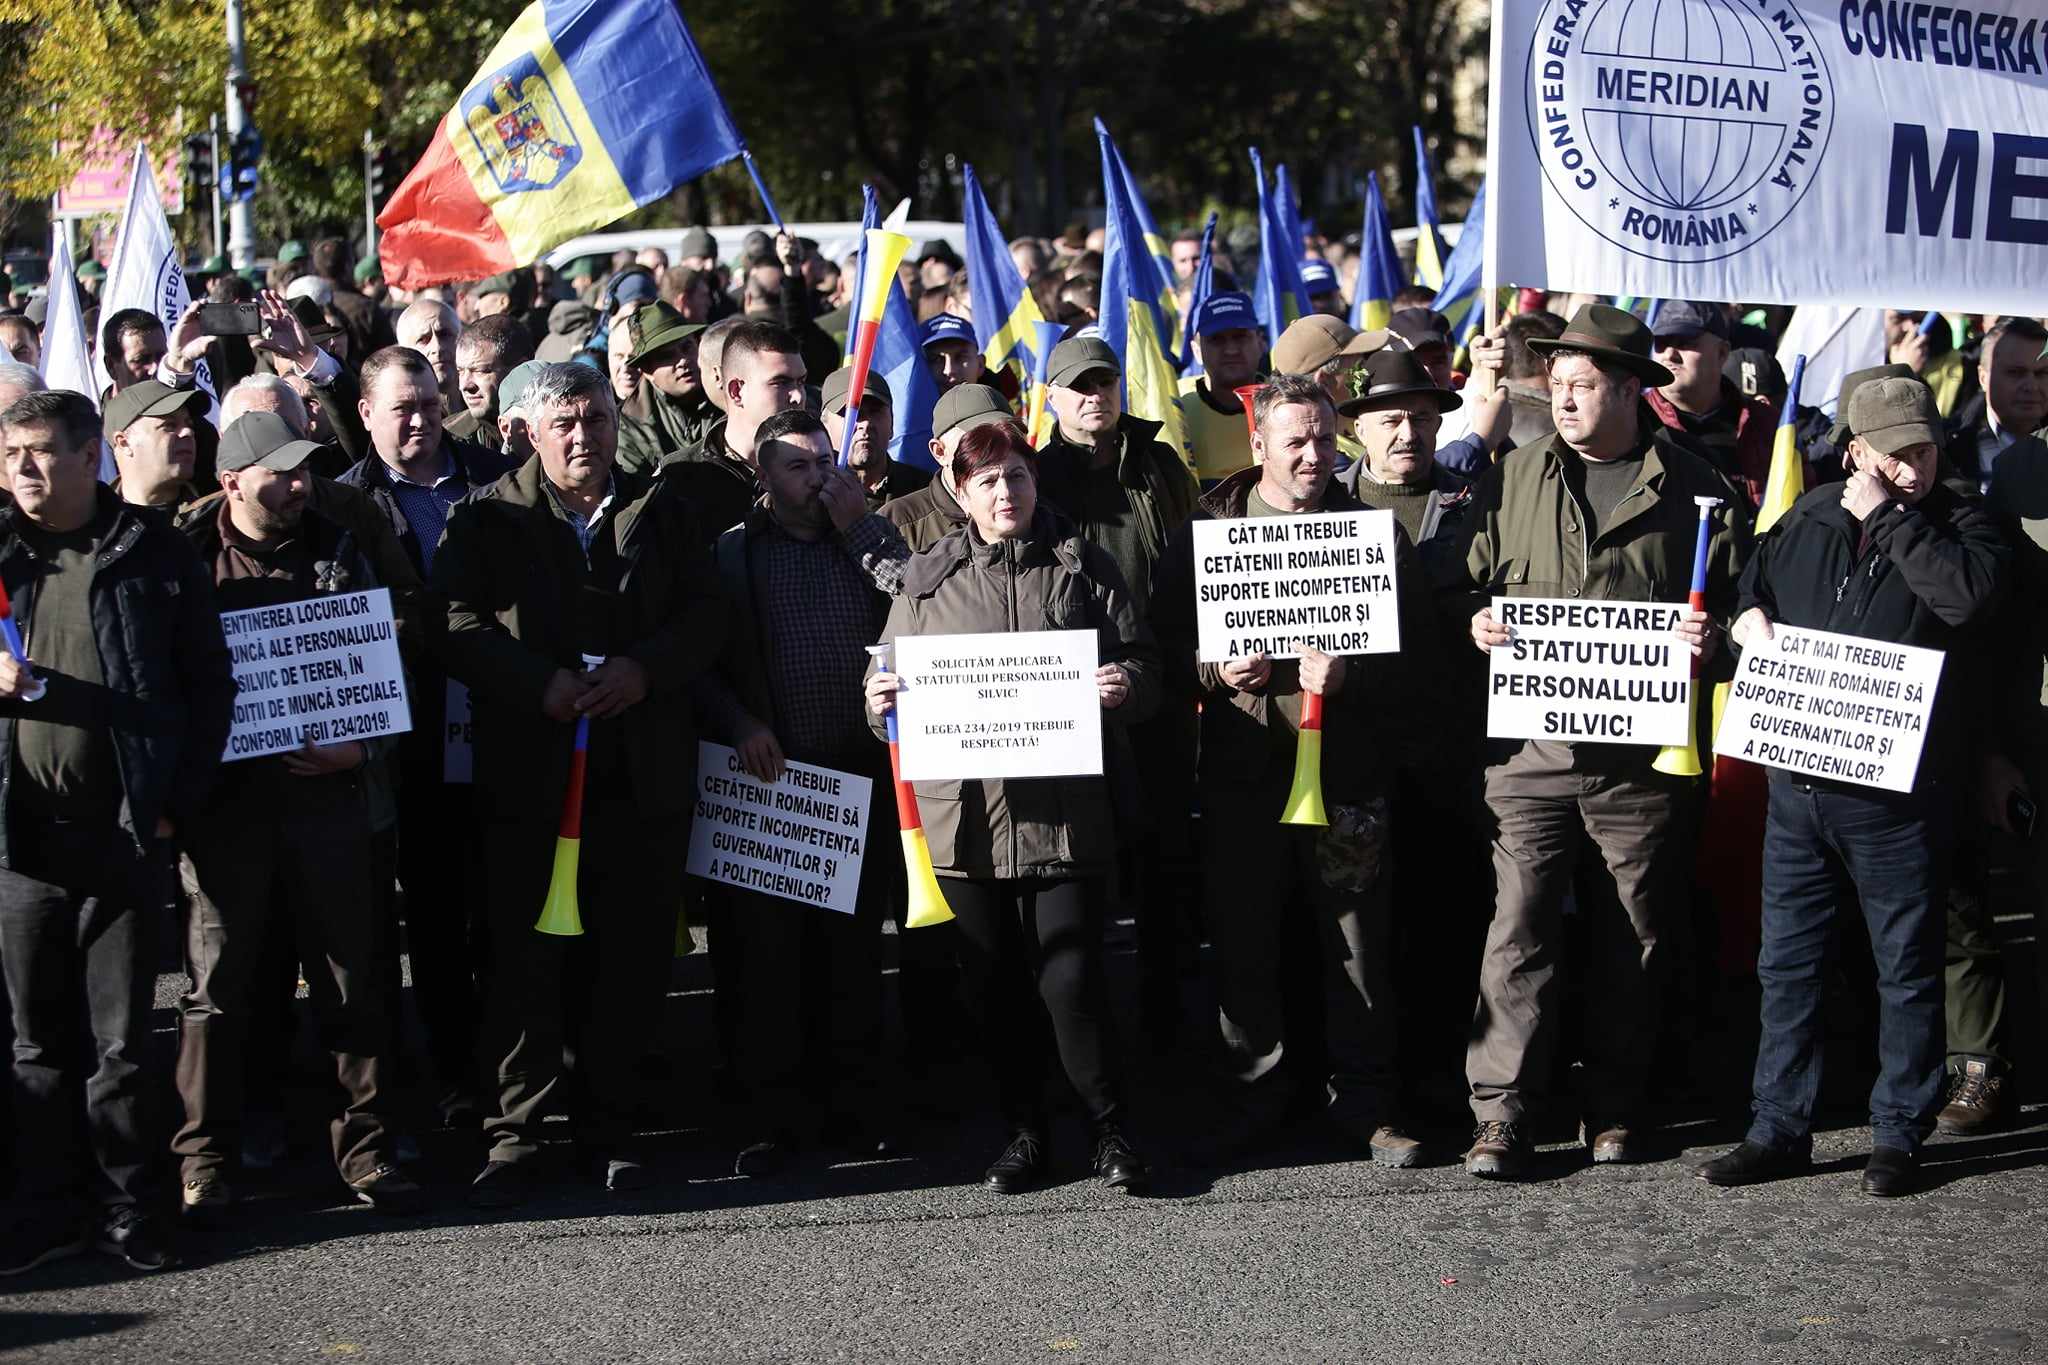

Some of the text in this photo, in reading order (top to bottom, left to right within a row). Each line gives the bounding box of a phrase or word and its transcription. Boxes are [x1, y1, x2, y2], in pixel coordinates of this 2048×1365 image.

[1839, 0, 2048, 75] CONFEDERA
[1597, 66, 1770, 112] MERIDIAN
[1622, 206, 1748, 247] ROMÂNIA
[1228, 520, 1358, 545] CÂT MAI TREBUIE
[1204, 543, 1385, 577] CETĂȚENII ROMÂNIEI SĂ
[1200, 574, 1392, 602] SUPORTE INCOMPETENȚA
[223, 596, 370, 640] ENȚINEREA LOCURILOR
[1225, 604, 1352, 629] GUVERNANȚILOR
[1502, 603, 1681, 631] RESPECTAREA
[230, 621, 392, 664] UNCĂ ALE PERSONALULUI
[1228, 639, 1239, 657] A
[1512, 638, 1669, 667] STATUTULUI
[1780, 632, 1907, 671] CÂT MAI TREBUIE
[237, 653, 365, 694] SILVIC DE TEREN, ÎN
[915, 670, 1081, 686] STATUTULUI PERSONALULUI
[931, 655, 1063, 669] SOLICITĂM APLICAREA
[233, 680, 403, 727] DIȚII DE MUNCĂ SPECIALE,
[977, 688, 1019, 699] SILVIC!
[1493, 673, 1687, 704] PERSONALULUI
[1829, 670, 1901, 700] ROMÂNIEI
[1903, 681, 1924, 703] SĂ
[1544, 711, 1633, 737] SILVIC!
[1735, 681, 1921, 735] SUPORTE INCOMPETENȚA
[231, 711, 391, 755] CONFORM LEGII 234/2019!
[925, 719, 1075, 735] LEGEA 234/2019 TREBUIE
[961, 737, 1040, 750] RESPECTATĂ!
[1750, 712, 1875, 752] GUVERNANȚILOR
[1743, 739, 1885, 782] A POLITICIENILOR?
[786, 768, 841, 796] TREBUIE
[704, 775, 860, 828] CETĂȚENII ROMÂNIEI SĂ
[697, 800, 861, 859] SUPORTE INCOMPETENȚA
[712, 831, 820, 874] GUVERNANȚILOR
[709, 858, 832, 903] A POLITICIENILOR?
